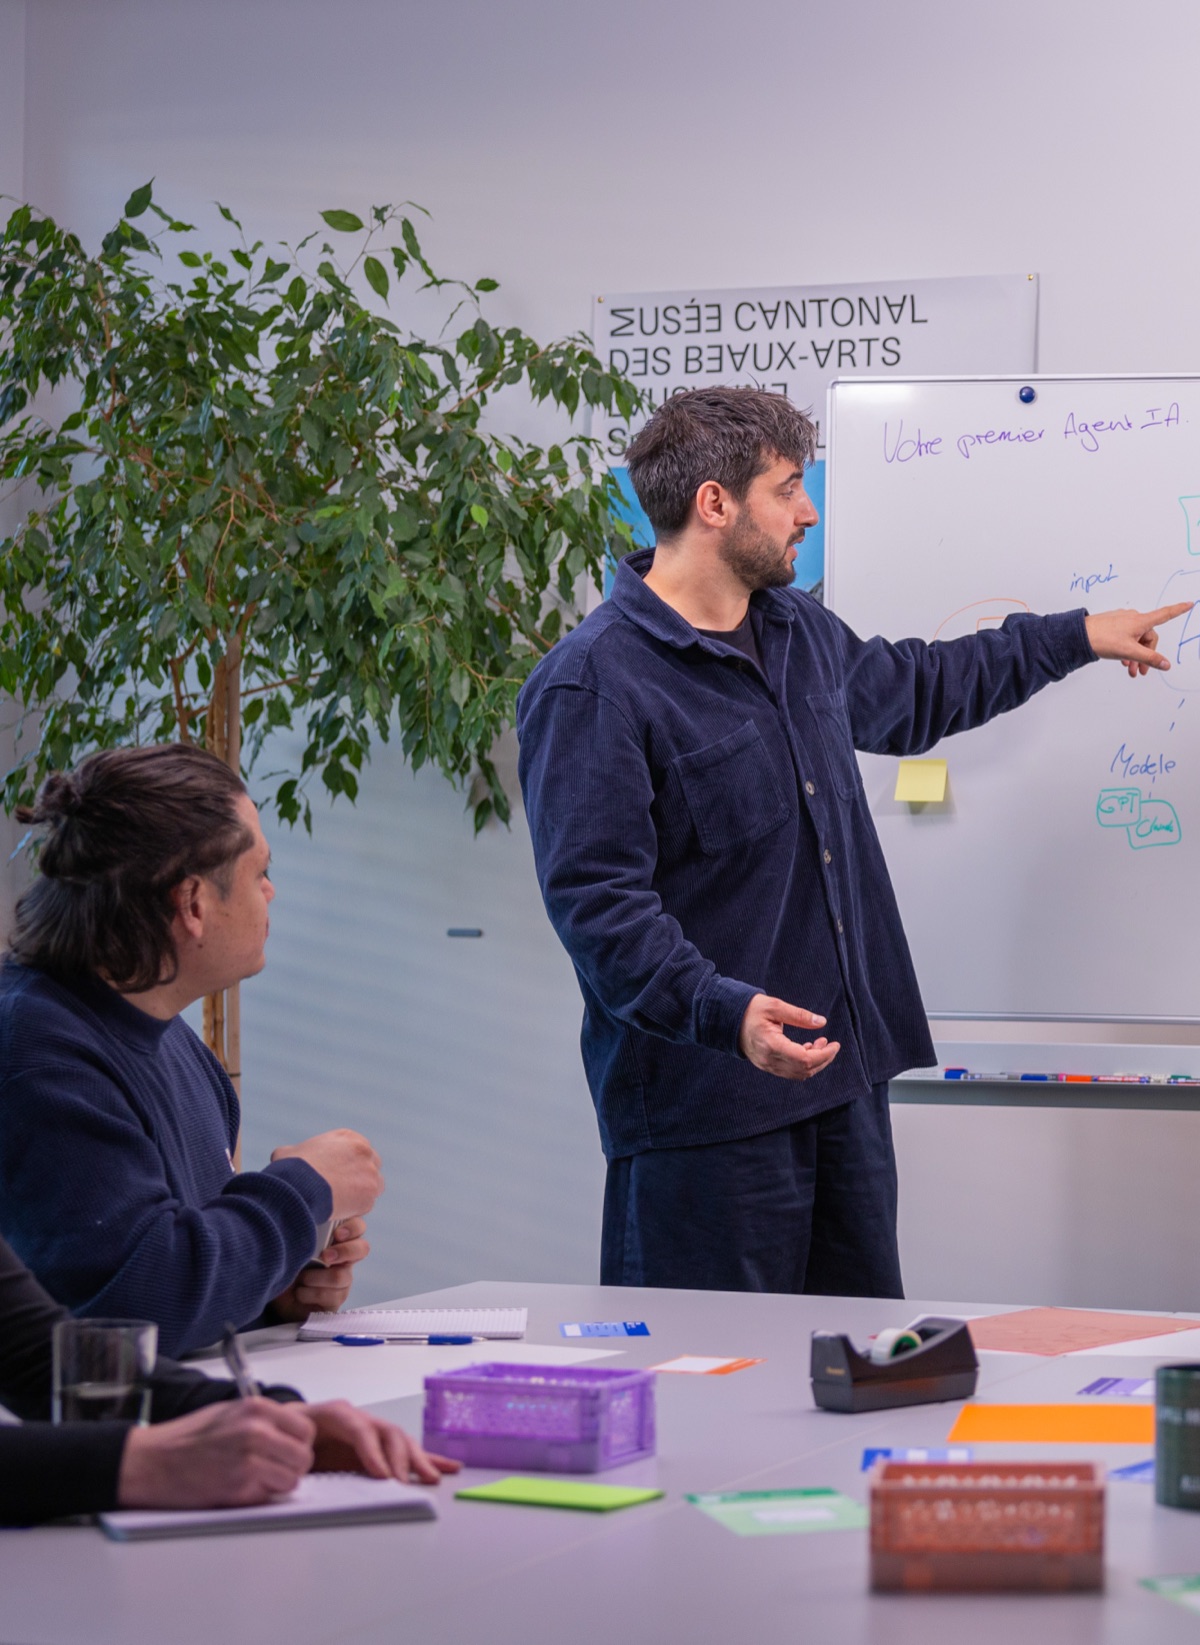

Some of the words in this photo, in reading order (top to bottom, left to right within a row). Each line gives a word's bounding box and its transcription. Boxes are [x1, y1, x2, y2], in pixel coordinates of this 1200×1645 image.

[609, 298, 723, 337] MUSÉE
[734, 295, 928, 332] CANTONAL
[609, 347, 671, 376] DES
[684, 337, 901, 375] BEAUX-ARTS
[884, 420, 942, 463] Votre
[956, 428, 1044, 459] premier
[1063, 412, 1132, 452] Agent
[1070, 563, 1119, 594] input
[1099, 792, 1138, 814] GPT
